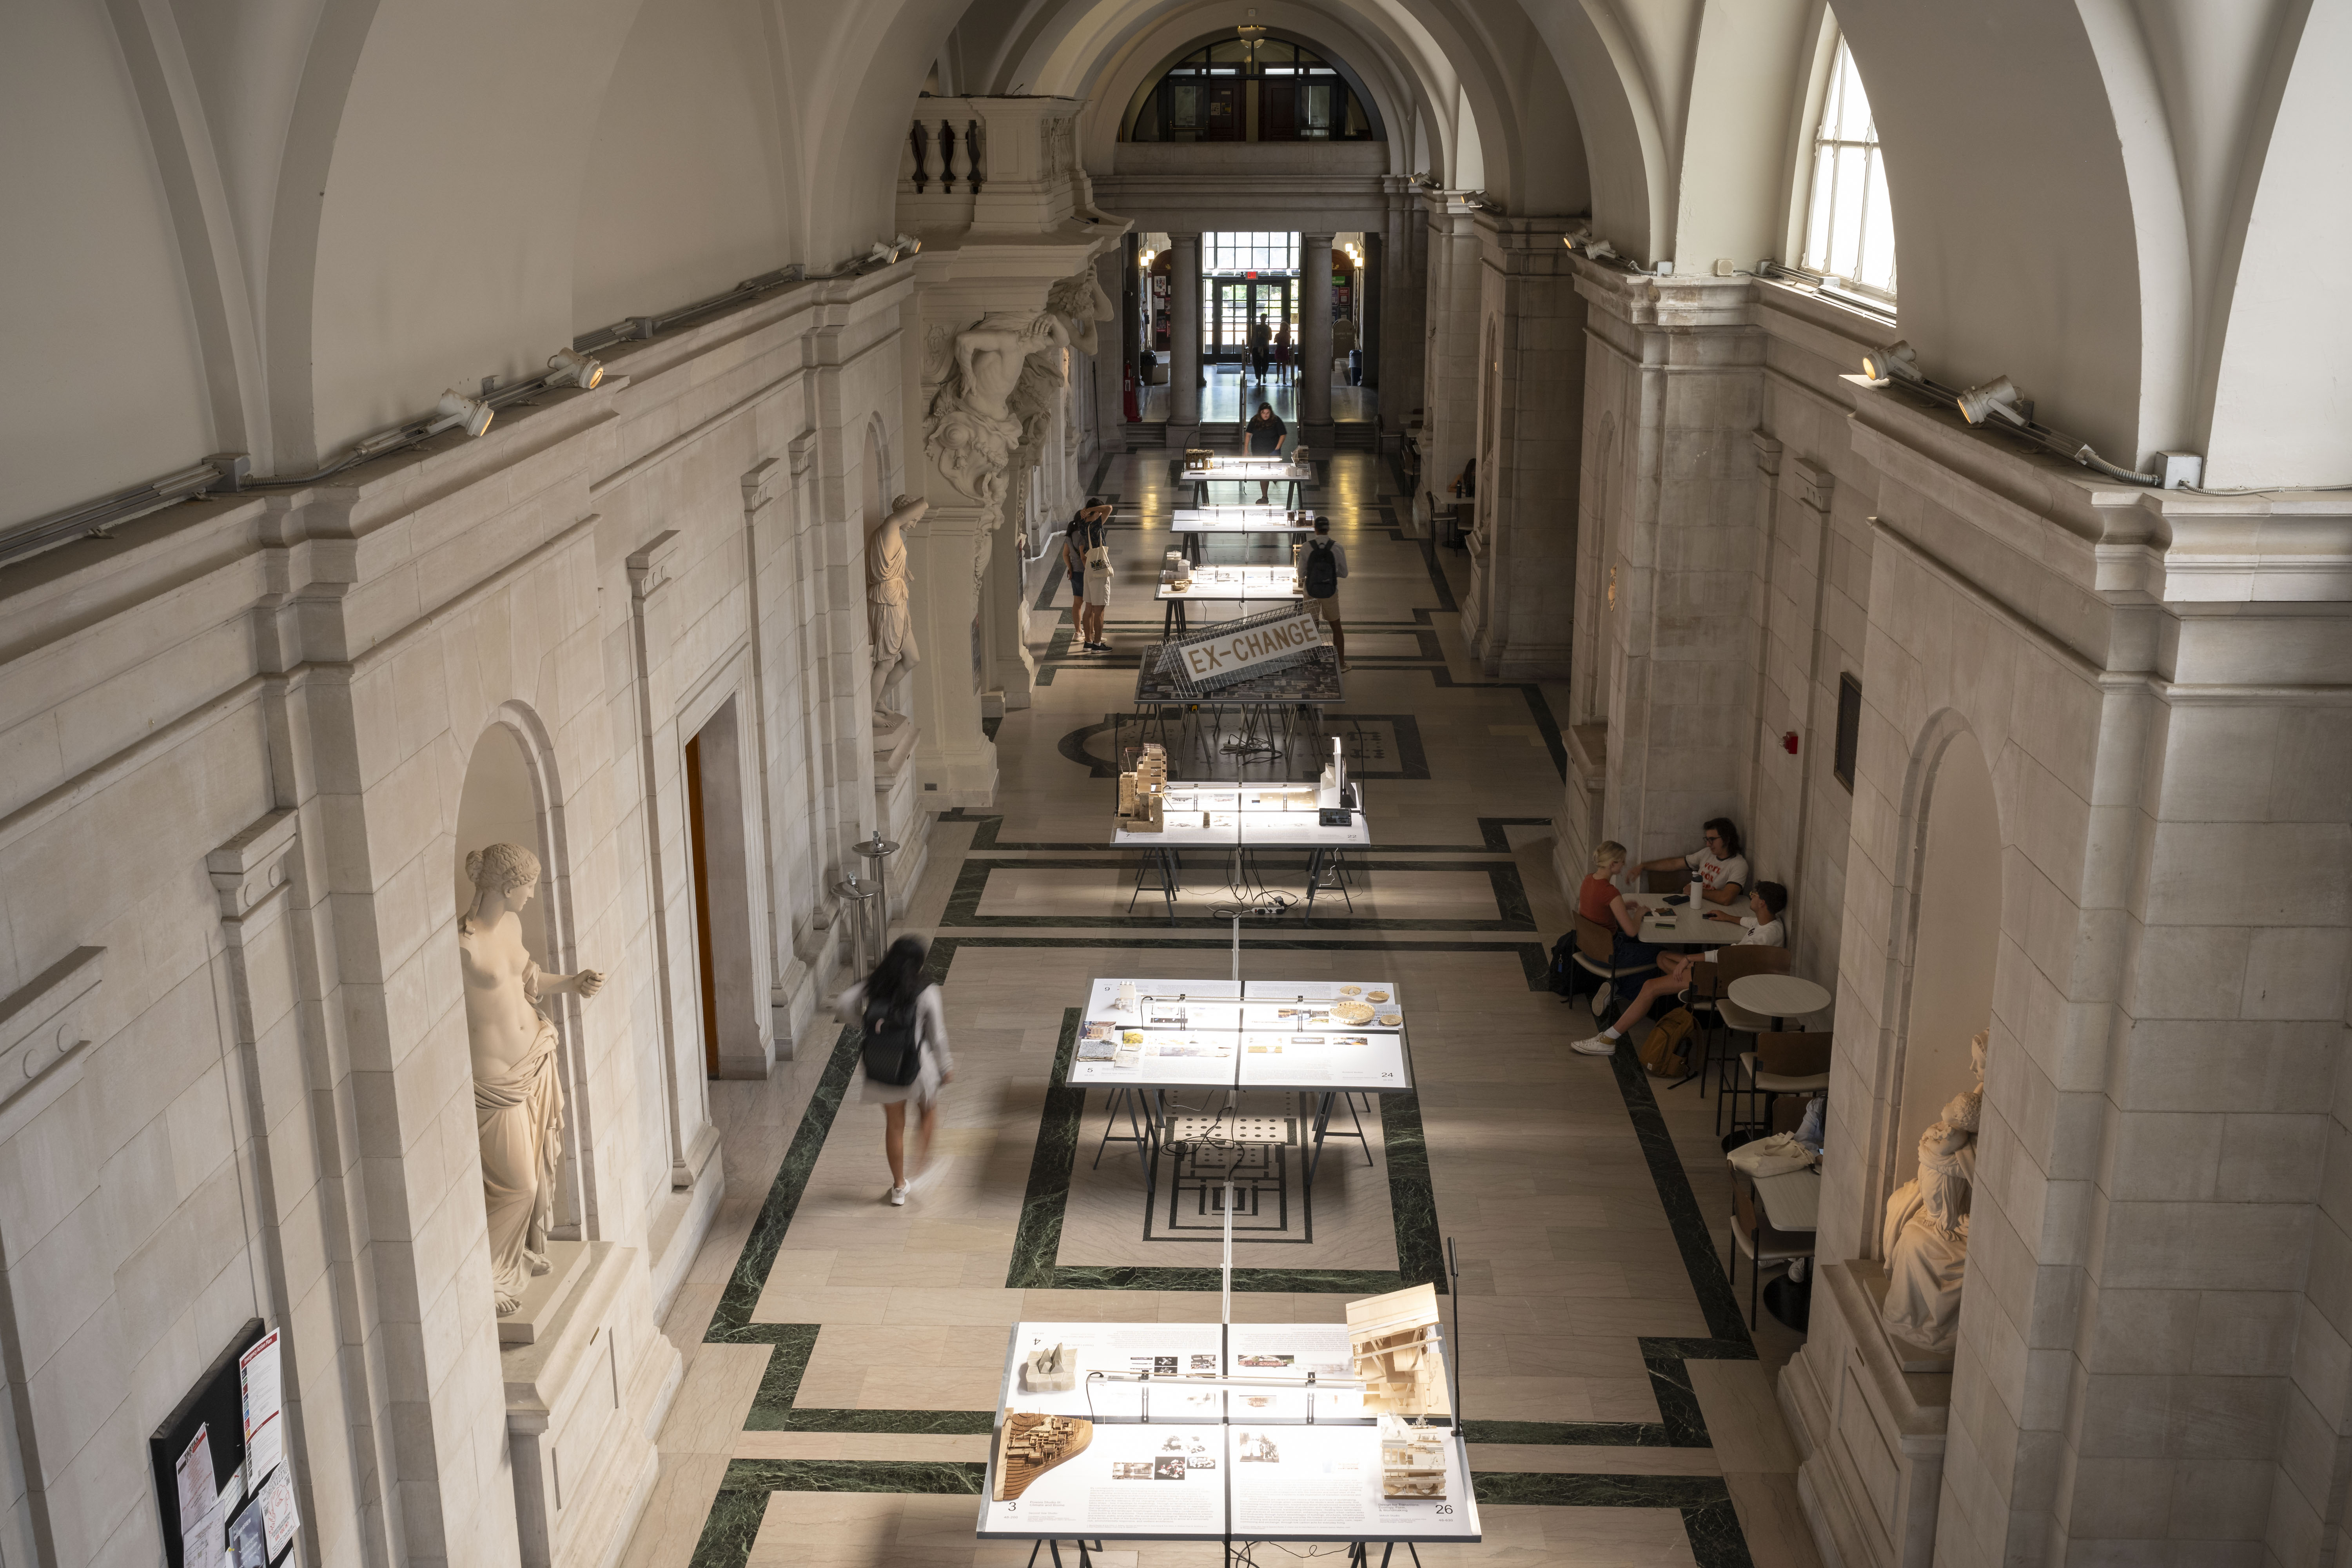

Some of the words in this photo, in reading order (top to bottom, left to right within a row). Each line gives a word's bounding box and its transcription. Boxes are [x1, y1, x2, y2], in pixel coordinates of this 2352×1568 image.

[1188, 619, 1318, 674] EX-CHANGE
[1704, 862, 1721, 875] VOTE
[244, 1349, 258, 1364] Emergency
[257, 1343, 266, 1353] Action
[184, 1435, 199, 1459] TARTAN
[1008, 1502, 1016, 1511] 3
[1435, 1504, 1453, 1514] 26
[242, 1518, 251, 1532] REVIEW
